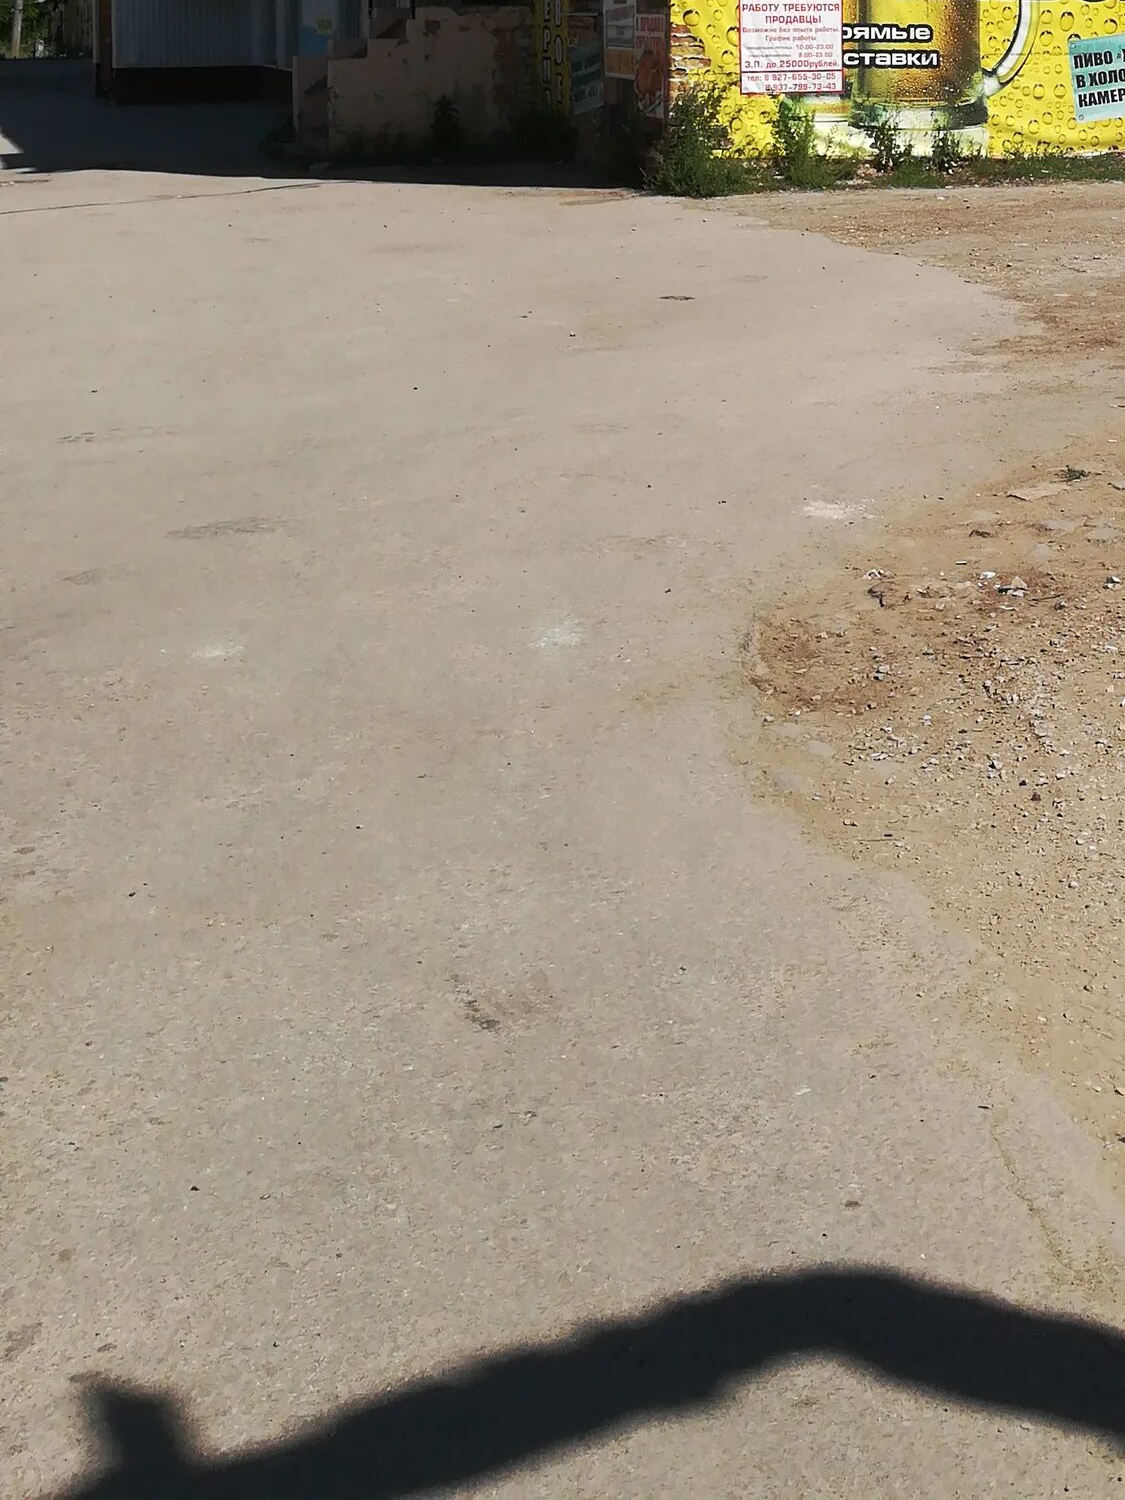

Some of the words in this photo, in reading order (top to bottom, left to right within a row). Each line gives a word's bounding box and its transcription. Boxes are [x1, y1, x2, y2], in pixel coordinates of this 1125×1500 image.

[742, 3, 779, 12] РАБОТУ
[783, 3, 840, 12] ТРЕБУЮТСЯ
[765, 15, 822, 25] ПРОДАВЦЫ
[842, 25, 932, 41] рямые
[843, 52, 938, 66] ставки
[1073, 51, 1114, 69] ПИВО
[1076, 75, 1087, 88] В
